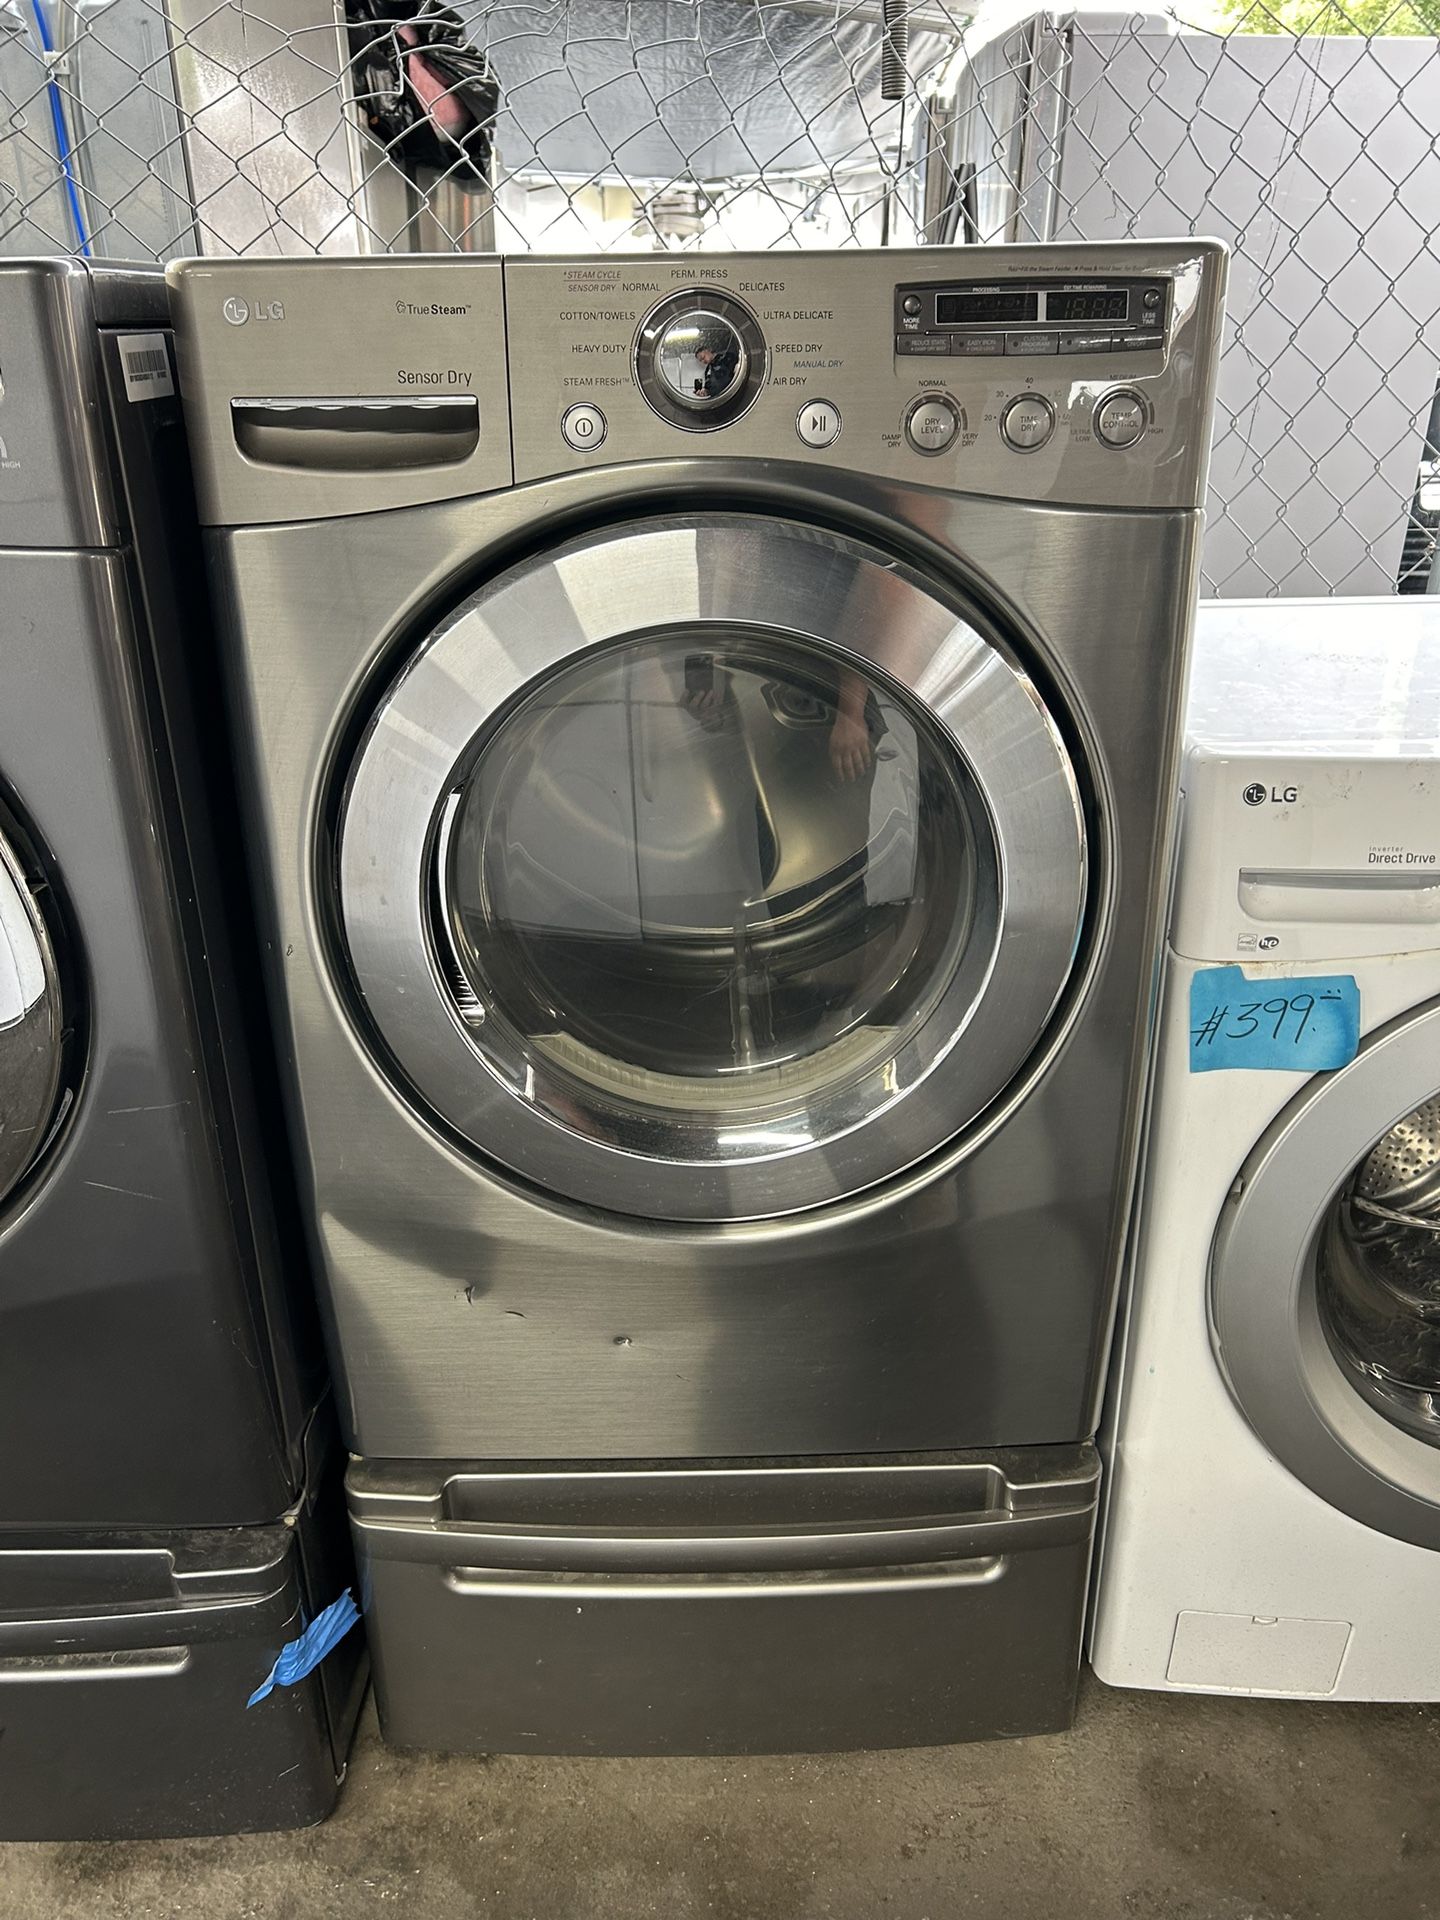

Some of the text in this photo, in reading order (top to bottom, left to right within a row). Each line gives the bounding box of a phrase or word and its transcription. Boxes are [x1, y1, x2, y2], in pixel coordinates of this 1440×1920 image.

[596, 271, 621, 279] CYCLE
[671, 270, 728, 278] PERM. PRESS
[568, 284, 616, 292] SENSOR DRY
[622, 283, 661, 291] NORMAL
[739, 283, 785, 291] DELICATES
[560, 312, 636, 320] COTTON/TOWELS
[763, 311, 833, 319] ULTRA DELICATE
[571, 345, 627, 353] HEAVY DUTY
[775, 344, 823, 353] SPEED DRY
[793, 360, 844, 369] MANUAL DRY
[397, 370, 472, 387] Sensor Dry
[563, 378, 593, 386] STEAM
[789, 378, 807, 386] DRY
[1271, 787, 1298, 803] LG
[1368, 852, 1436, 863] Direct Drive
